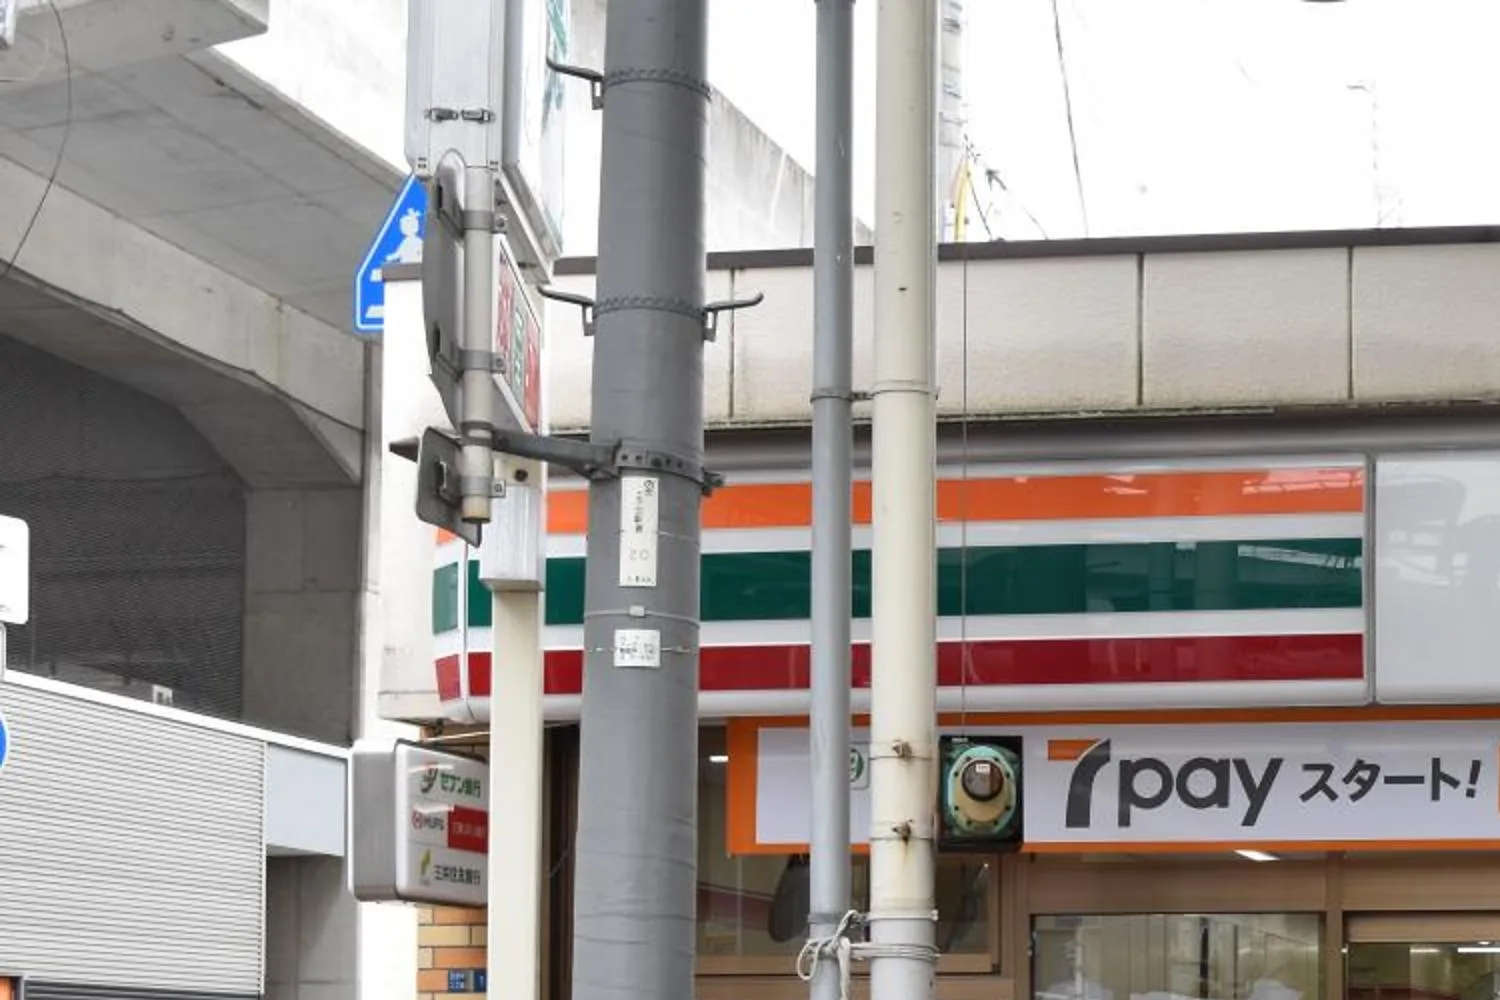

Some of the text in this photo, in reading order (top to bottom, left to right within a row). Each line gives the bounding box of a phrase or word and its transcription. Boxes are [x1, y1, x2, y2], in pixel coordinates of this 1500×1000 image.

[1047, 738, 1284, 828] 7pay
[1299, 757, 1482, 803] スタート!
